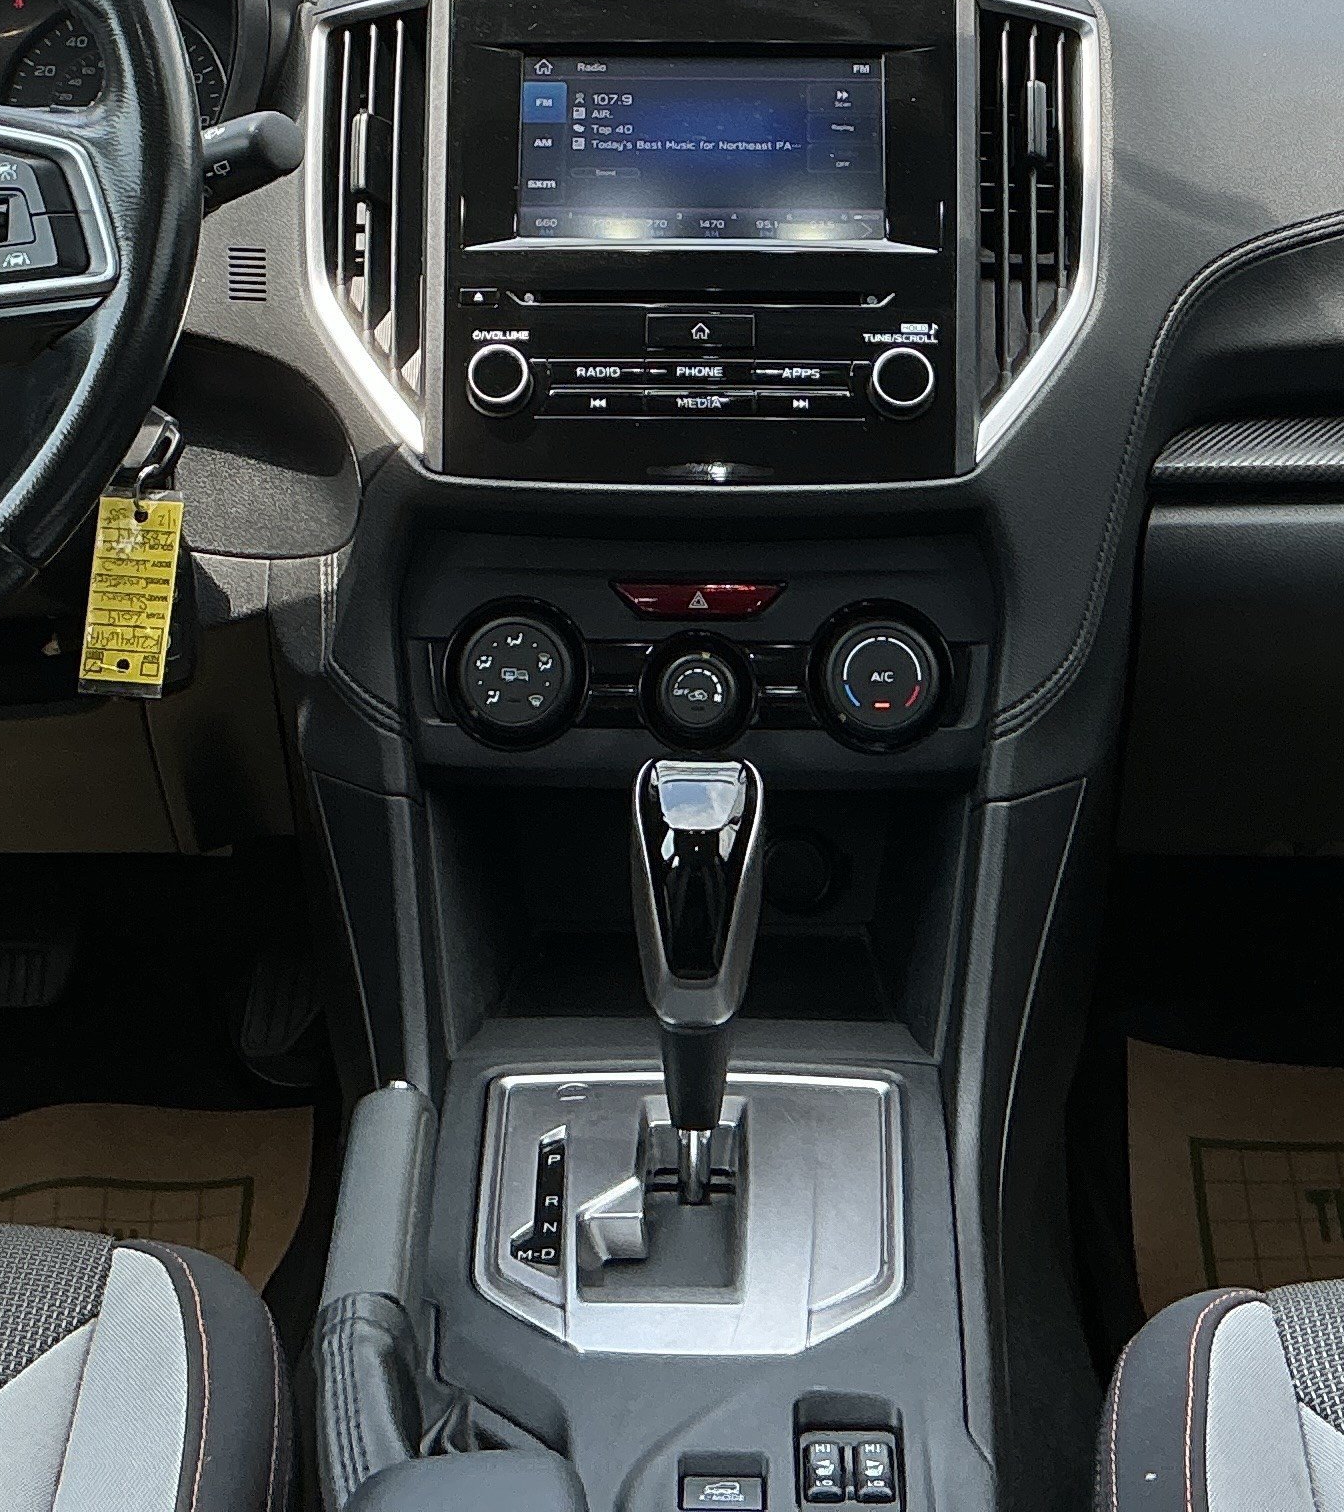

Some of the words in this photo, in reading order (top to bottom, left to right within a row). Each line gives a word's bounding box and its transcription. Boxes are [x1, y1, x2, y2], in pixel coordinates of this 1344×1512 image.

[65, 36, 88, 48] 40
[34, 65, 56, 76] 20
[577, 62, 607, 72] Radio
[68, 78, 82, 86] 40
[535, 98, 553, 107] FM
[593, 93, 633, 106] 107.9
[592, 124, 612, 136] Top
[616, 124, 633, 135] 40
[534, 138, 553, 147] AM
[591, 139, 633, 151] Today's
[636, 139, 662, 150] Best
[665, 139, 696, 150] Music
[699, 139, 716, 150] for
[719, 139, 772, 151] Northeast
[699, 219, 725, 229] 1470
[903, 324, 928, 332] HOLD
[862, 333, 939, 343] TUNE/SCROLL
[576, 366, 621, 378] RADIO
[676, 366, 723, 378] PHONE
[782, 367, 821, 379] APPS
[677, 397, 722, 409] MEDIA
[151, 560, 172, 568] BODY
[107, 610, 142, 625] 2019
[871, 671, 895, 683] A/C
[547, 1154, 561, 1166] P
[544, 1195, 559, 1207] R
[542, 1221, 558, 1233] N
[815, 1443, 831, 1454] HI
[864, 1443, 881, 1454] HI
[815, 1479, 834, 1487] LO
[867, 1479, 885, 1487] LO
